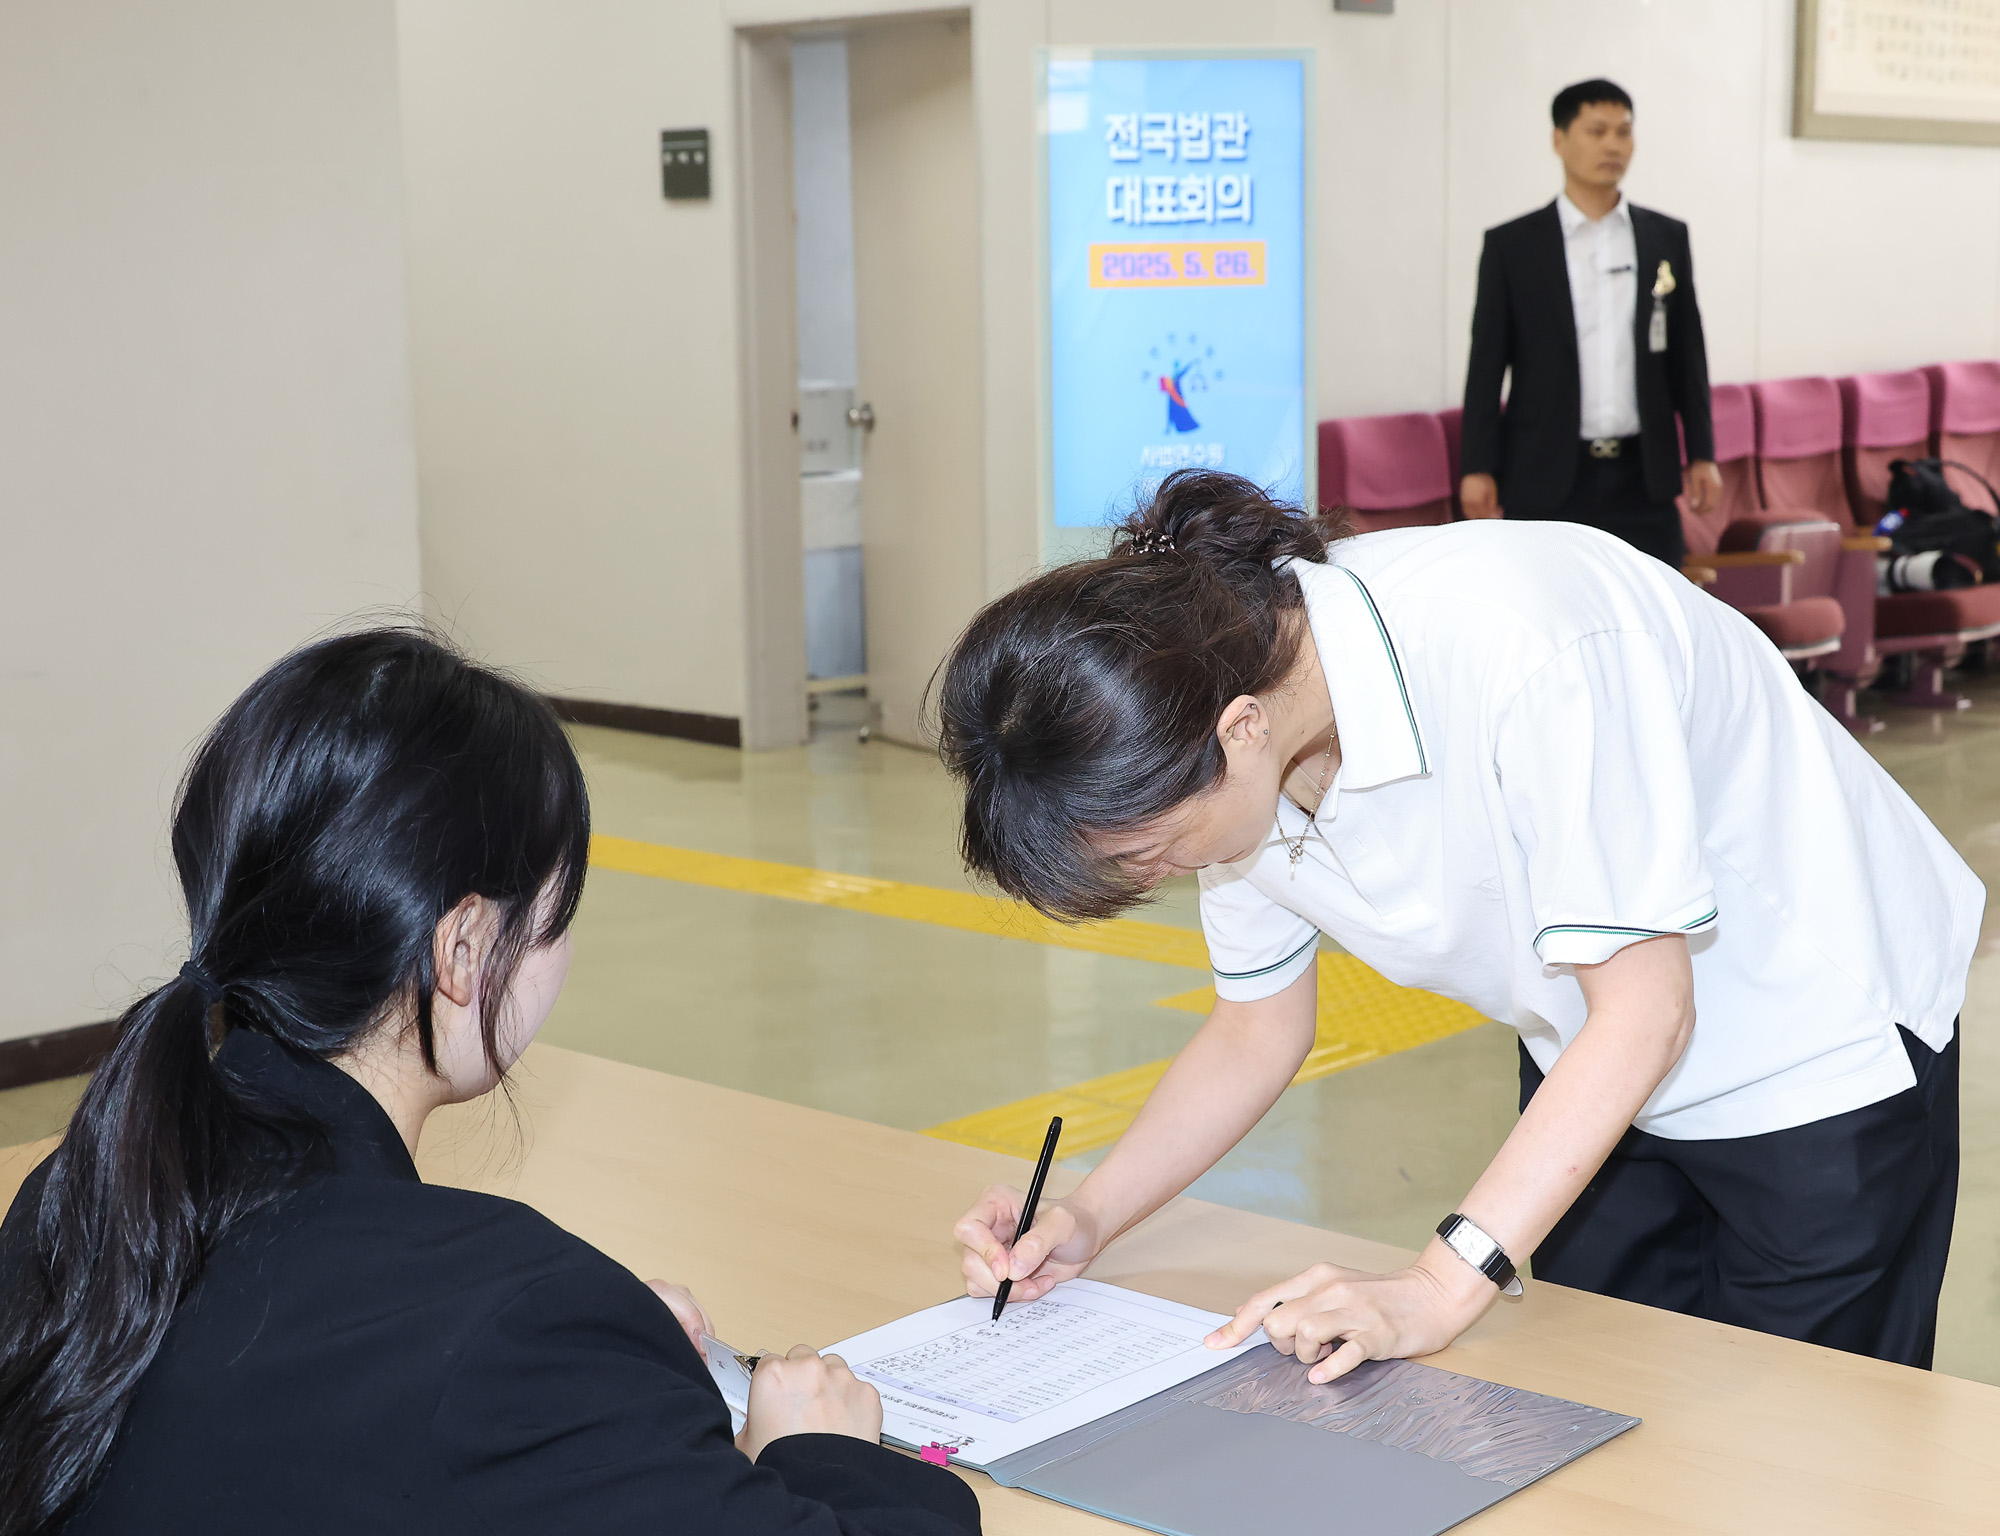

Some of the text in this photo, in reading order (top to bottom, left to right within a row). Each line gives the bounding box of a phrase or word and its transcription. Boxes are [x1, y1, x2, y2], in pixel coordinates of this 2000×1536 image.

[1104, 111, 1250, 162] 전국법관
[1105, 173, 1253, 225] 대표회의
[1102, 251, 1179, 281] 2025.
[1183, 251, 1209, 280] 5.
